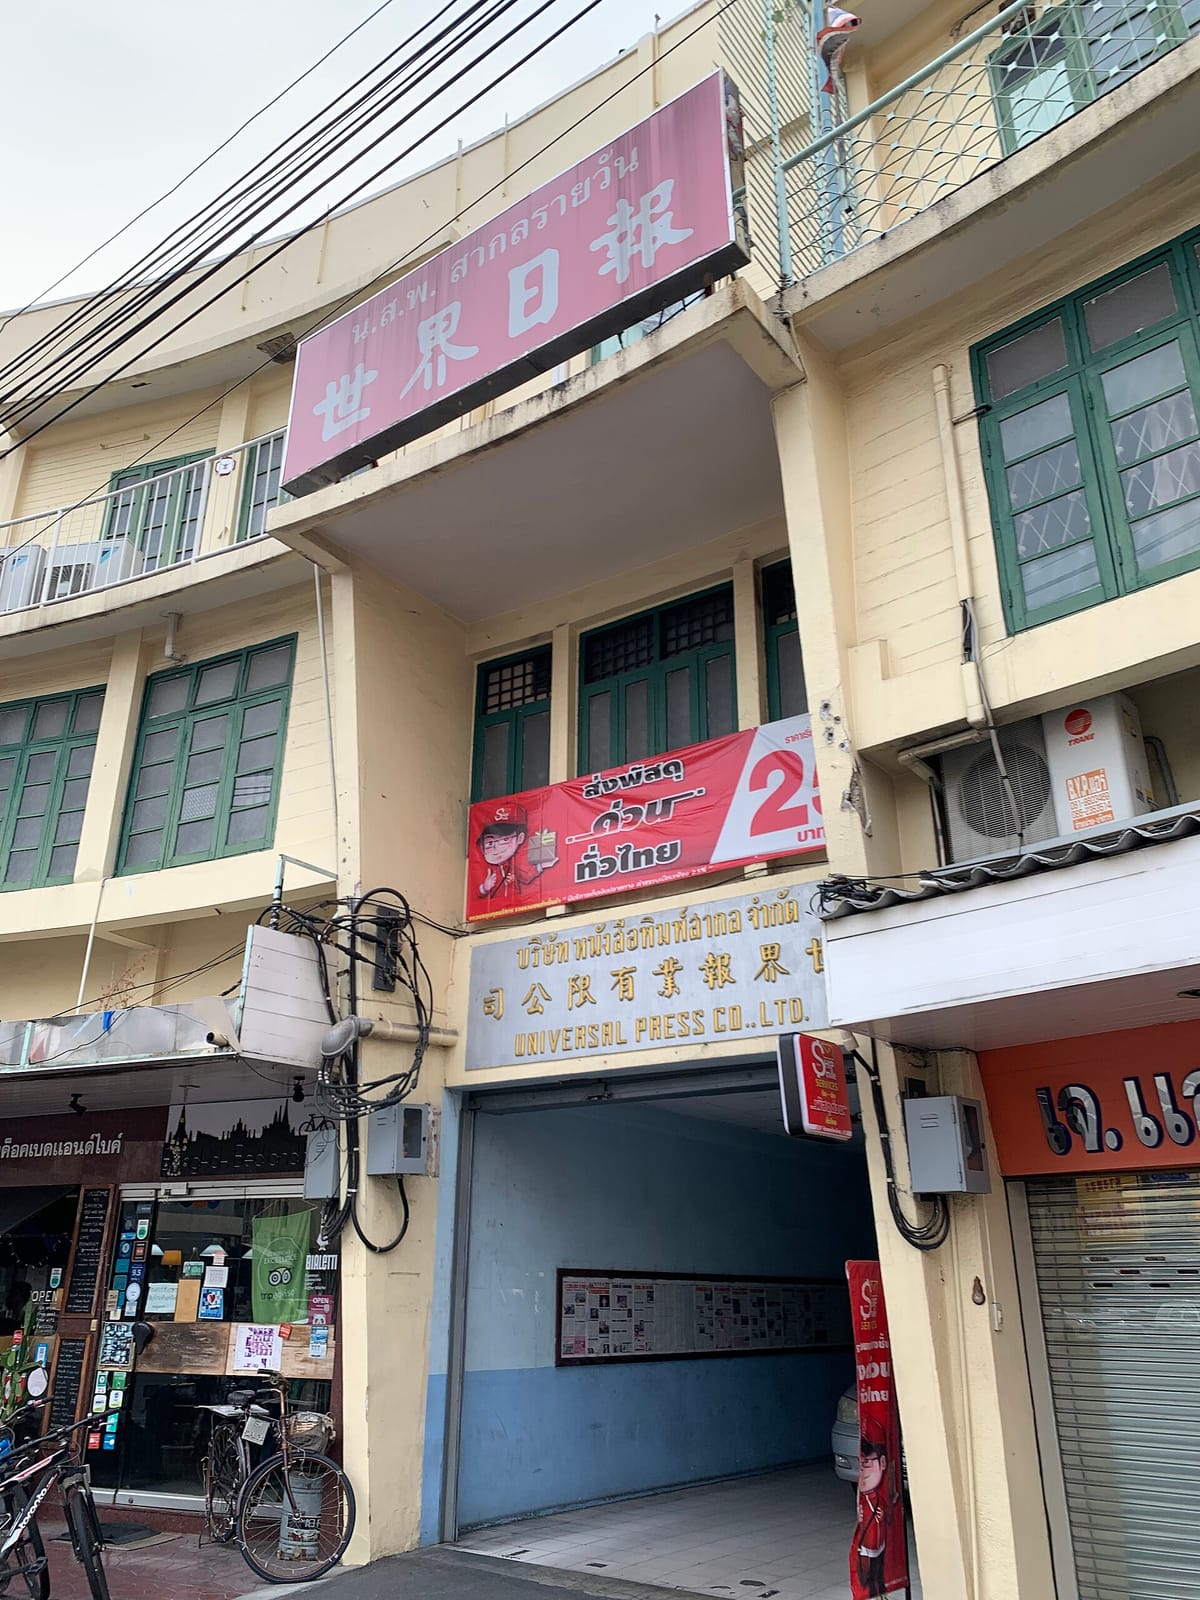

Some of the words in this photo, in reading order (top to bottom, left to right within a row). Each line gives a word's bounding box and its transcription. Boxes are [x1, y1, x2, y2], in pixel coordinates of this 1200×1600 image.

[450, 146, 640, 284] สากลรายวัน
[312, 179, 694, 441] 世界日報
[1067, 733, 1096, 746] TRANE
[583, 758, 685, 799] ส่งพัสดุ
[748, 750, 823, 840] 2
[575, 795, 690, 840] ด่วน
[575, 841, 680, 883] ทั่วไทย
[517, 934, 569, 970] บริษัท
[747, 889, 799, 930] จำกัด
[514, 1022, 628, 1057] UNIVERSAL
[635, 1009, 705, 1042] PRESS
[0, 1132, 123, 1159] ค็อคเบดแอนด์ไบค์
[18, 1487, 47, 1528] toronto
